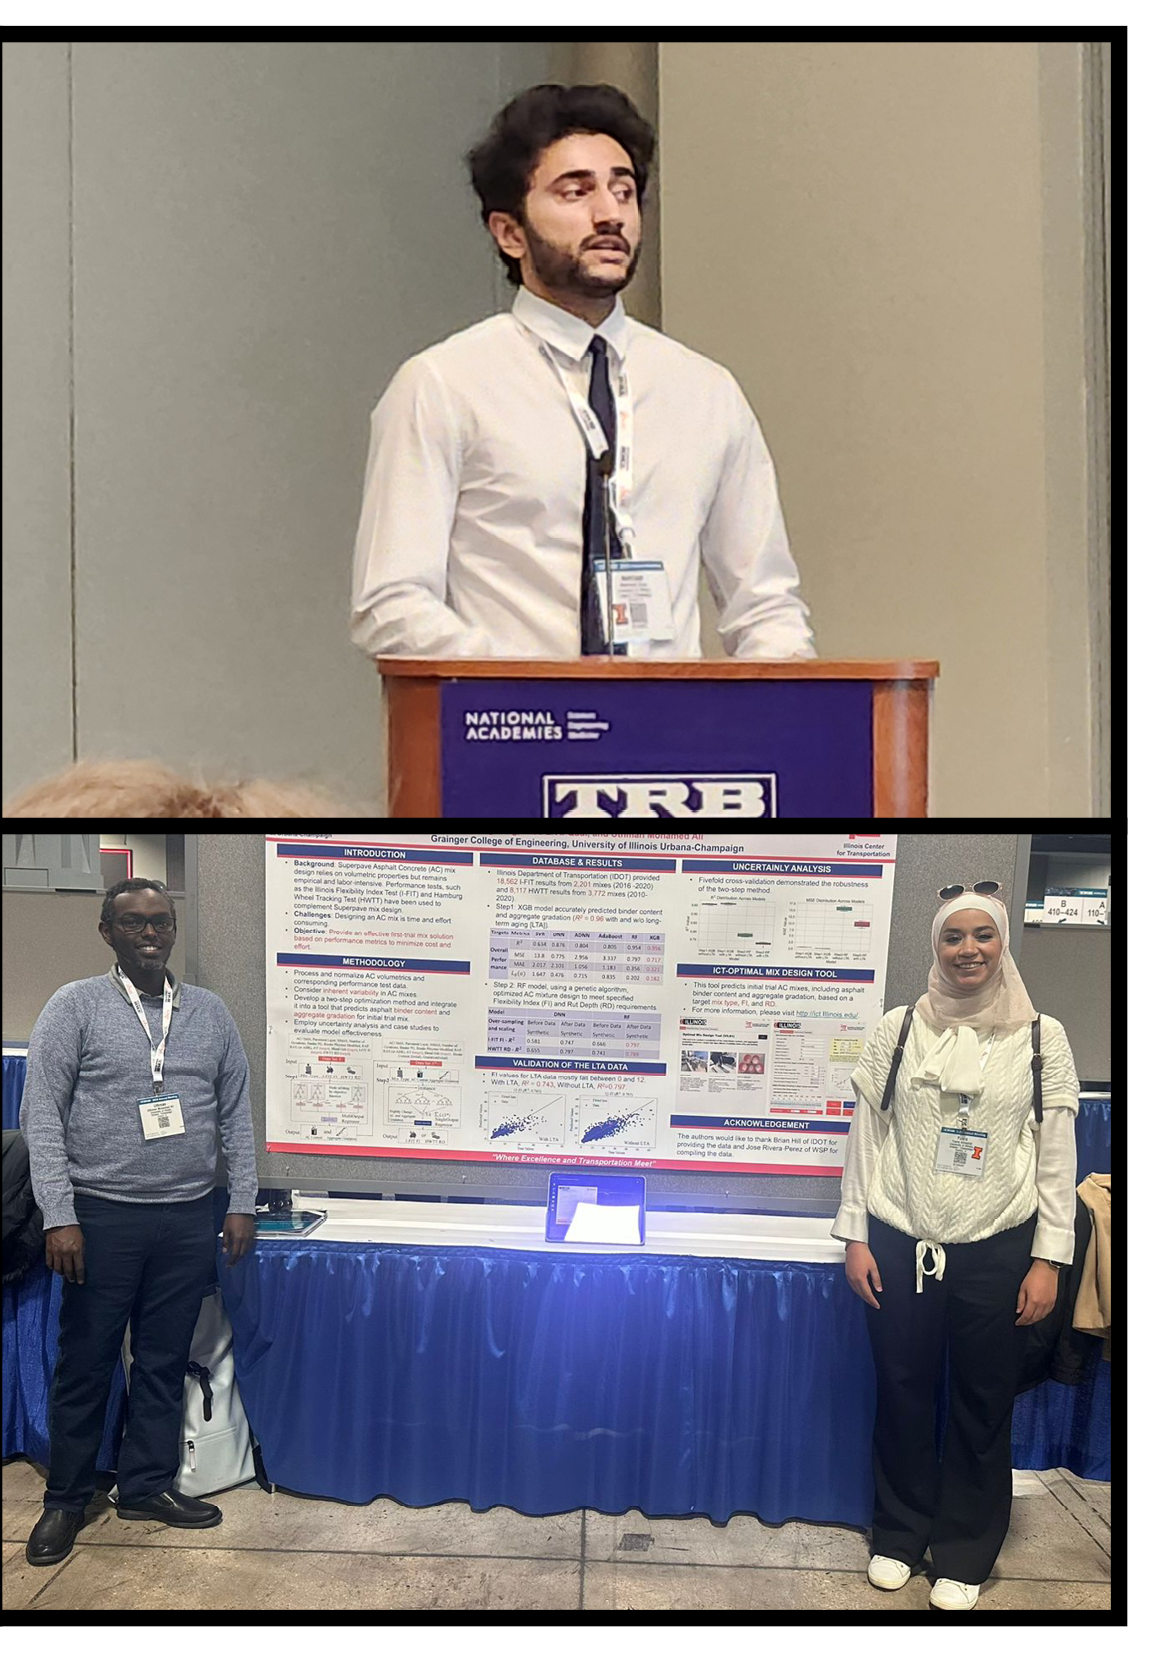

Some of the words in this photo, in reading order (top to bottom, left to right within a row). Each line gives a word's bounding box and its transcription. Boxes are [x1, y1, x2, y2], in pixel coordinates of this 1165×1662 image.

[465, 711, 555, 725] NATIONAL
[465, 726, 562, 741] ACADEMIES
[554, 782, 765, 818] TRB
[430, 833, 469, 844] Grainger
[470, 836, 503, 847] College
[504, 837, 514, 846] of
[515, 837, 570, 849] Engineering,
[572, 840, 616, 851] University
[617, 841, 627, 850] of
[628, 841, 658, 851] Illinois
[660, 842, 744, 854] Urbana-Champaign
[344, 848, 406, 859] INTRODUCTION
[847, 850, 890, 858] Transportation
[338, 861, 372, 870] Superpave
[373, 863, 397, 871] Asphalt
[398, 864, 427, 872] Concrete
[428, 866, 443, 874] (AC)
[532, 857, 576, 866] DATABASE
[577, 858, 584, 866] &
[585, 858, 623, 867] RESULTS
[732, 863, 790, 872] UNCERTAINLY
[790, 864, 832, 873] ANALYSIS
[497, 869, 516, 877] Illinois
[517, 869, 554, 878] Department
[563, 871, 608, 880] Transportation
[609, 873, 632, 881] (IDOT)
[519, 878, 535, 886] I-FIT
[612, 881, 632, 890] (2016
[698, 876, 724, 884] Fivefold
[776, 879, 820, 887] demonstrated
[1061, 900, 1067, 908] B
[1099, 901, 1105, 909] A
[342, 957, 406, 968] METHODOLOGY
[713, 967, 764, 976] ICT-OPTIMAL
[765, 968, 781, 976] MIX
[782, 969, 813, 977] DESIGN
[815, 970, 838, 978] TOOL
[293, 985, 322, 994] Consider
[349, 989, 379, 997] variability
[493, 981, 508, 989] Step
[693, 981, 707, 989] This
[811, 986, 840, 994] including
[692, 998, 711, 1007] target
[513, 1059, 560, 1068] VALIDATION
[561, 1061, 572, 1069] OF
[574, 1062, 590, 1070] THE
[591, 1062, 606, 1070] LTA
[607, 1063, 628, 1071] DATA
[723, 1119, 810, 1129] ACKNOWLEDGEMENT
[678, 1132, 690, 1140] The
[773, 1136, 790, 1144] Brian
[811, 1138, 827, 1146] IDOT
[828, 1138, 838, 1146] for
[677, 1142, 705, 1150] providing
[812, 1146, 829, 1154] WSP
[521, 1155, 561, 1164] Excellence
[579, 1157, 633, 1167] Transportation
